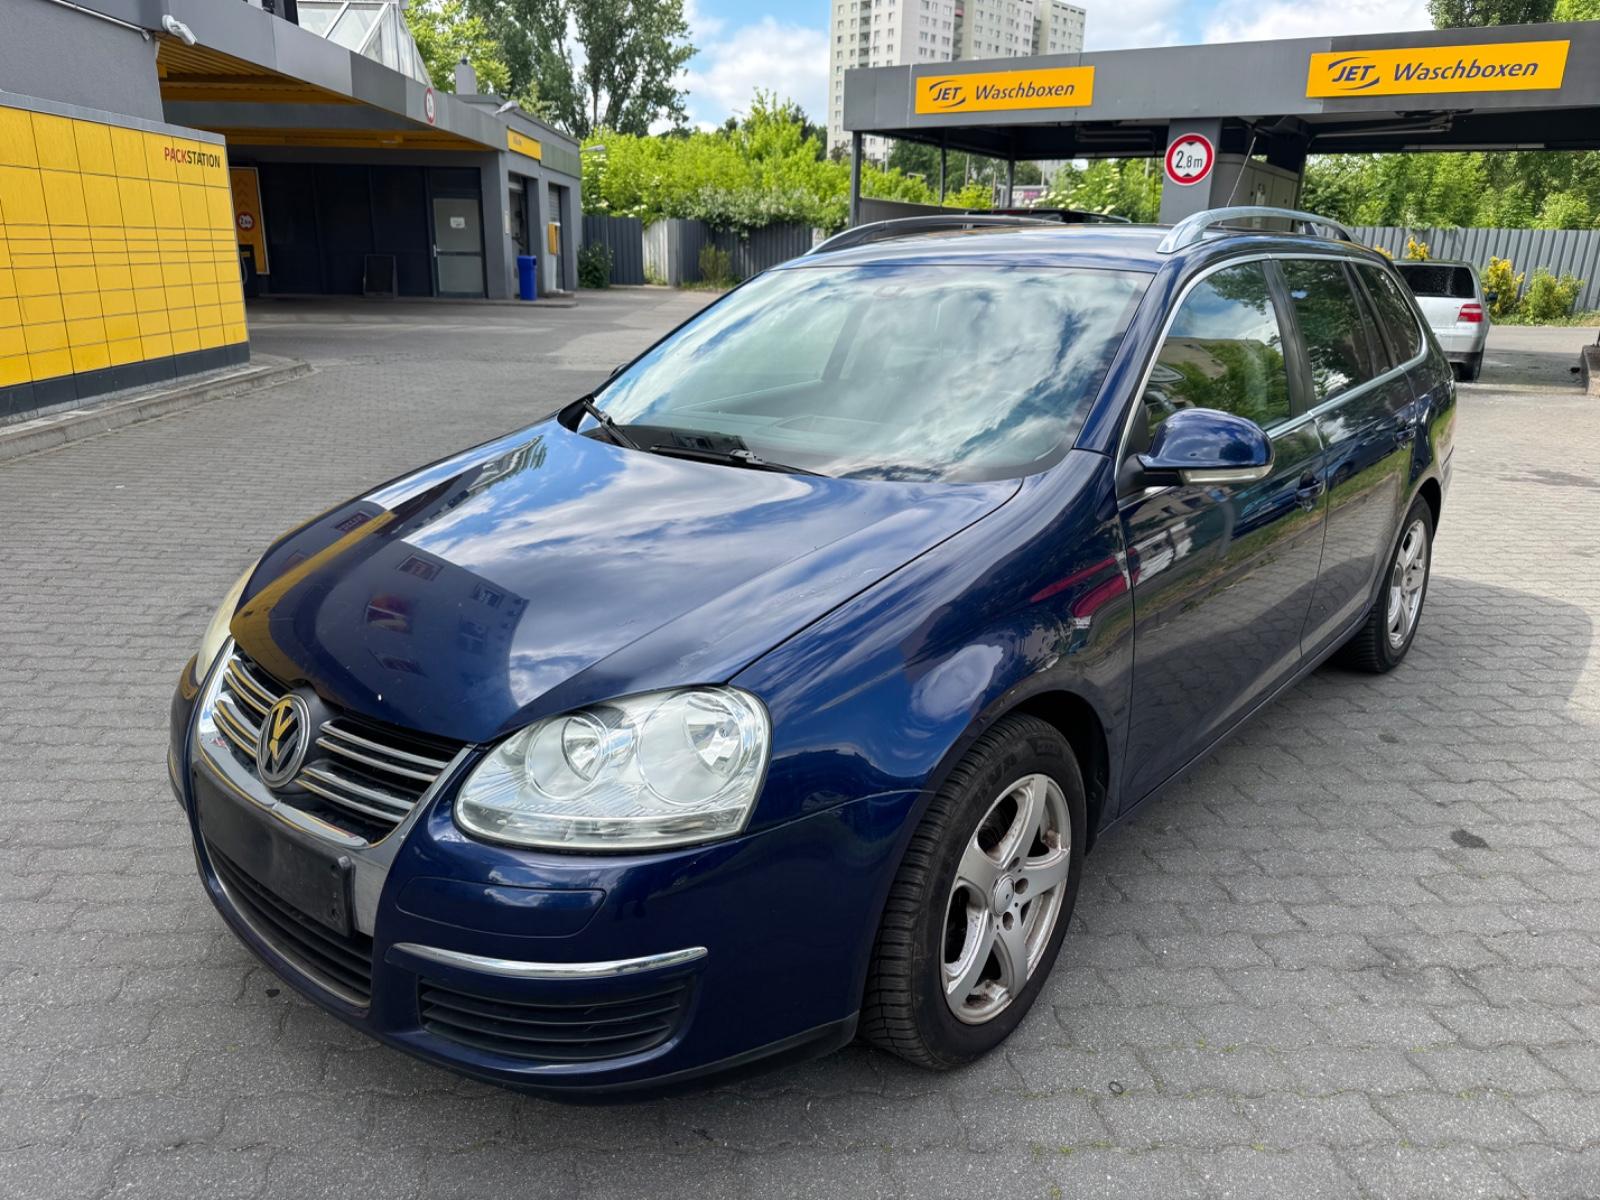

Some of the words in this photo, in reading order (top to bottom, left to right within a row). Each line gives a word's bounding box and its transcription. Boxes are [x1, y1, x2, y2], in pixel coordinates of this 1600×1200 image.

[1331, 64, 1376, 83] JET
[1393, 58, 1539, 82] Waschboxen
[933, 86, 963, 101] JET
[975, 81, 1075, 100] Waschboxen
[164, 146, 220, 168] PACKSTATION
